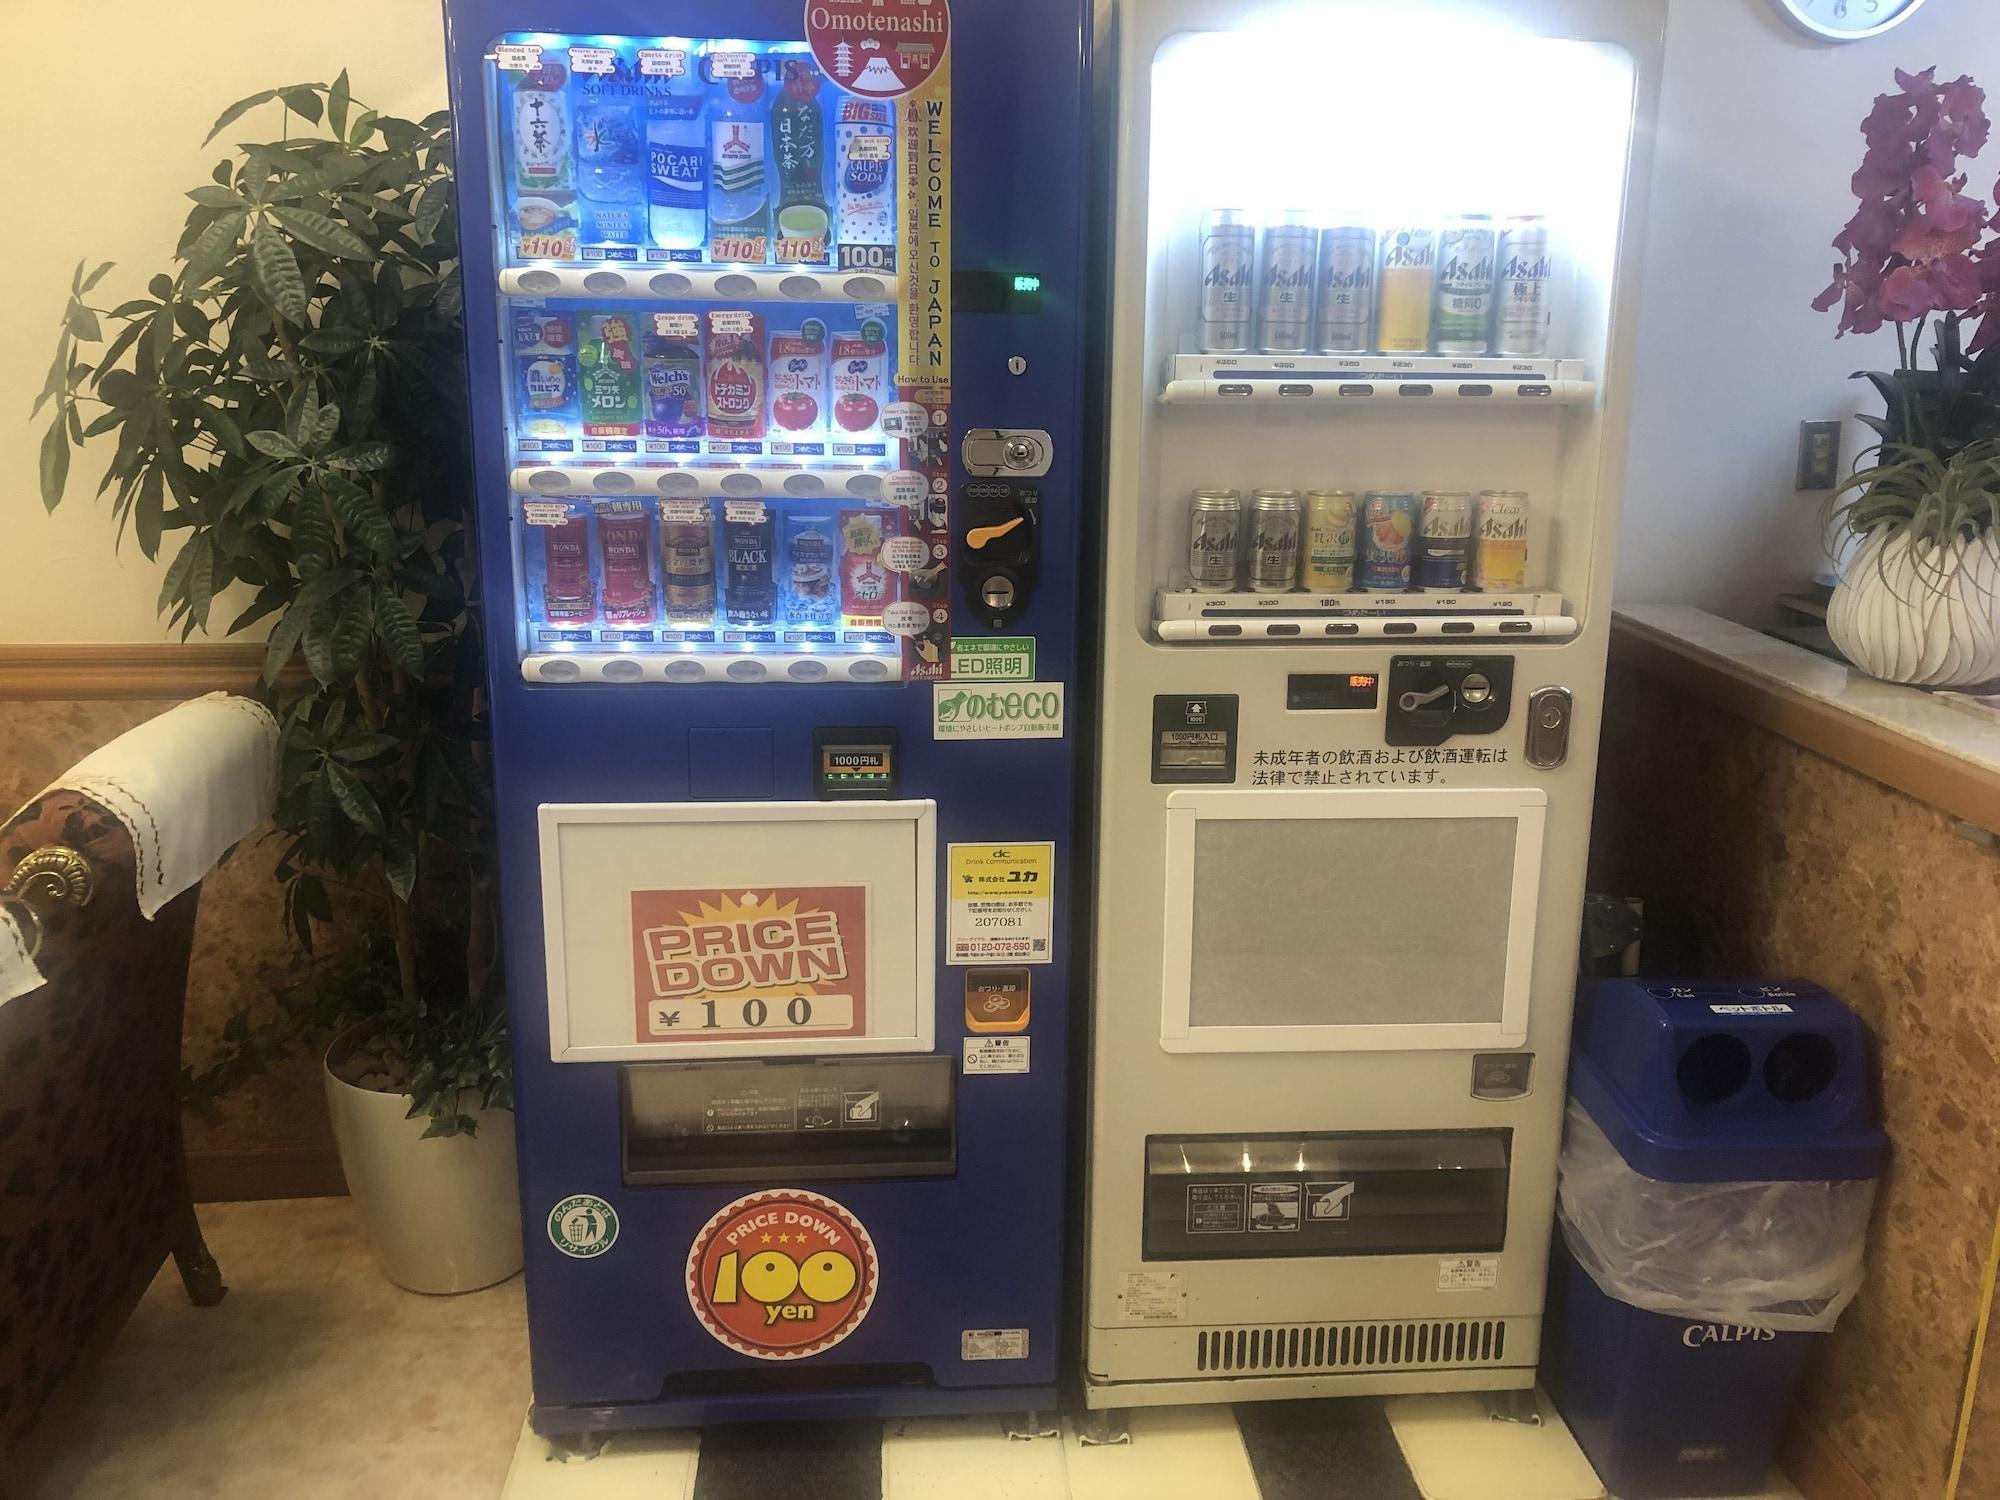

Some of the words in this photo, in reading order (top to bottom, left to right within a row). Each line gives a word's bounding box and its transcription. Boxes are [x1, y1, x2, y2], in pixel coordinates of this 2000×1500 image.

[811, 7, 943, 33] Omotenashi
[583, 84, 617, 96] SOFT
[624, 85, 672, 97] DRINKS
[843, 101, 870, 121] BIG
[529, 97, 551, 154] 十六茶
[779, 118, 799, 170] 日本茶
[651, 151, 703, 167] POCARI
[907, 126, 919, 187] 欢迎到日本
[926, 100, 943, 228] WELCOME
[651, 162, 699, 178] SWEAT
[850, 160, 884, 173] CALPIS
[849, 170, 883, 182] SODA
[714, 239, 753, 259] ¥110
[929, 241, 940, 268] TO
[1223, 291, 1237, 303] 生
[1279, 291, 1294, 303] 生
[1336, 293, 1351, 304] 生
[927, 279, 943, 366] JAPAN
[650, 371, 689, 385] Welch's
[897, 375, 918, 385] How
[920, 376, 930, 384] to
[932, 375, 949, 385] Use
[673, 386, 687, 396] 50
[592, 395, 626, 409] メロン
[1480, 517, 1528, 539] Asahi
[1193, 530, 1238, 552] Asahi
[1253, 530, 1297, 552] Asahi
[728, 549, 767, 563] BLACK
[1208, 555, 1222, 566] 生
[1266, 555, 1281, 565] 生
[957, 643, 1030, 652] 省エネで環境にやさしい
[911, 663, 943, 676] Asahi
[966, 691, 1060, 720] のむeco
[1170, 733, 1219, 742] 1000円札入口
[834, 756, 879, 765] 1000円札
[1252, 747, 1509, 767] 未成年者の飲酒および飲酒運転は
[1251, 768, 1447, 787] 法律で禁止されています。
[975, 917, 1023, 927] 207081
[648, 914, 836, 962] PRICE
[970, 942, 1030, 951] 0120-072-590
[655, 946, 842, 993] DOWN
[554, 1198, 612, 1222] のんだあとは
[726, 1212, 779, 1246] PRICE
[784, 1211, 842, 1246] DOWN
[560, 1238, 609, 1254] リサイクル
[712, 1250, 857, 1303] 100
[765, 1304, 815, 1326] yen
[1682, 1324, 1777, 1349] CALPIS
